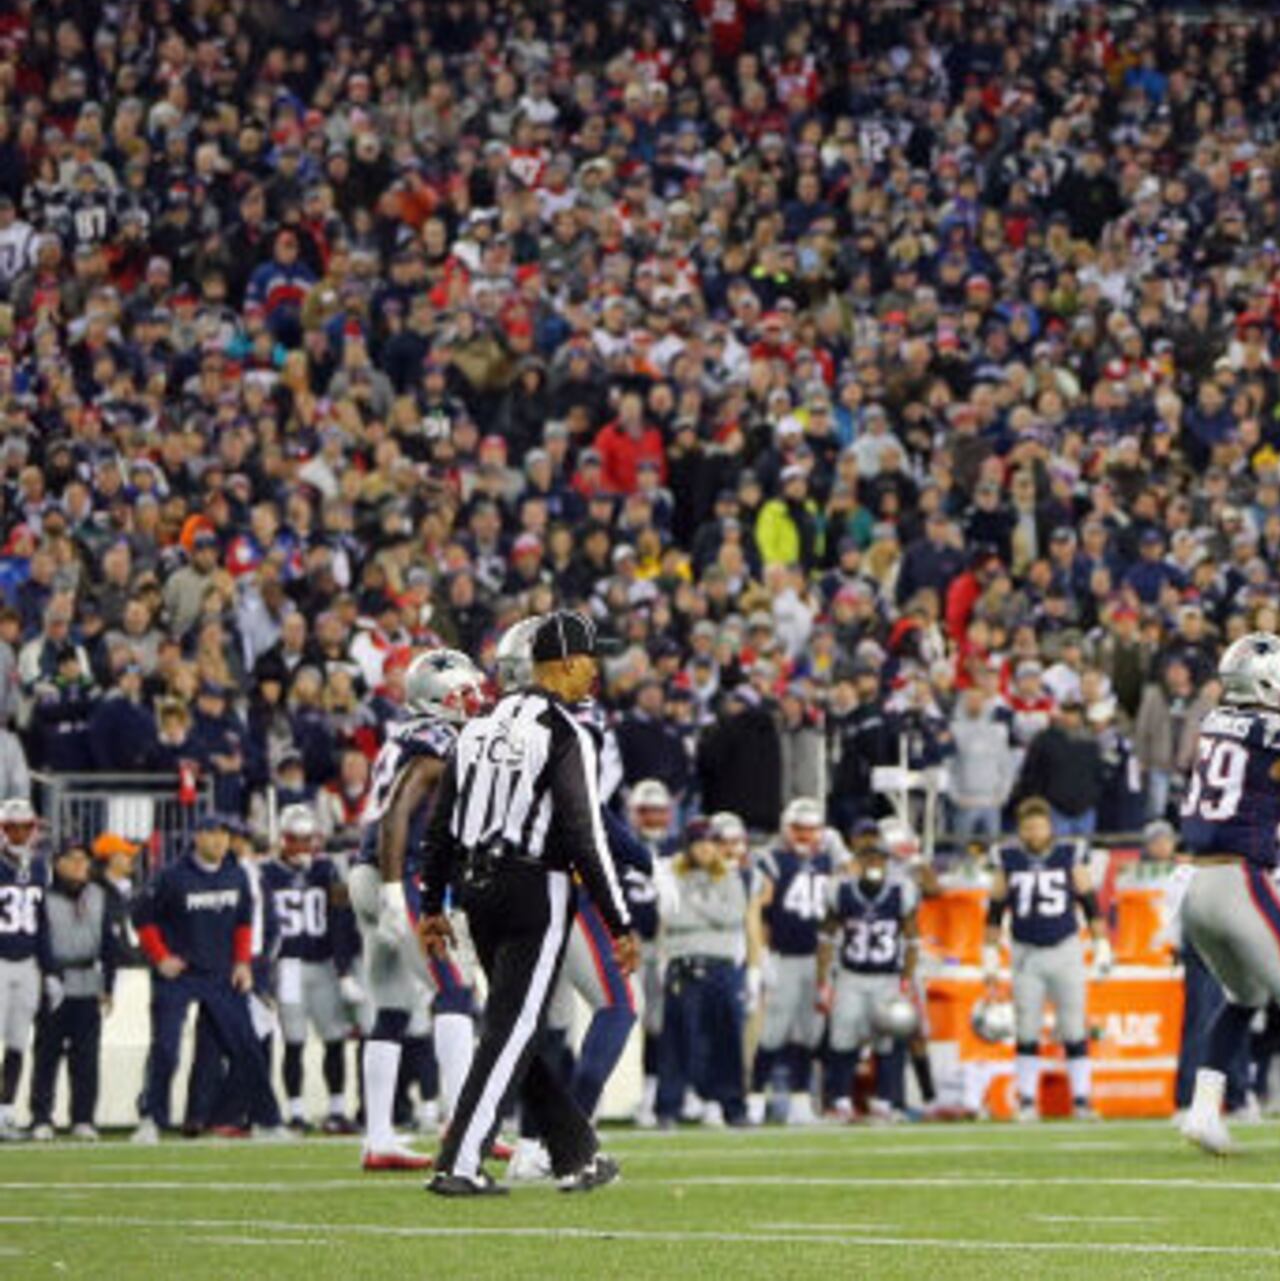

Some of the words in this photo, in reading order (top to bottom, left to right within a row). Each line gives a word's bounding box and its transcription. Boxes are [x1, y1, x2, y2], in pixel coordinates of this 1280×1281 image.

[275, 889, 327, 937] 50
[1010, 869, 1069, 917] 75
[844, 920, 898, 963] 33
